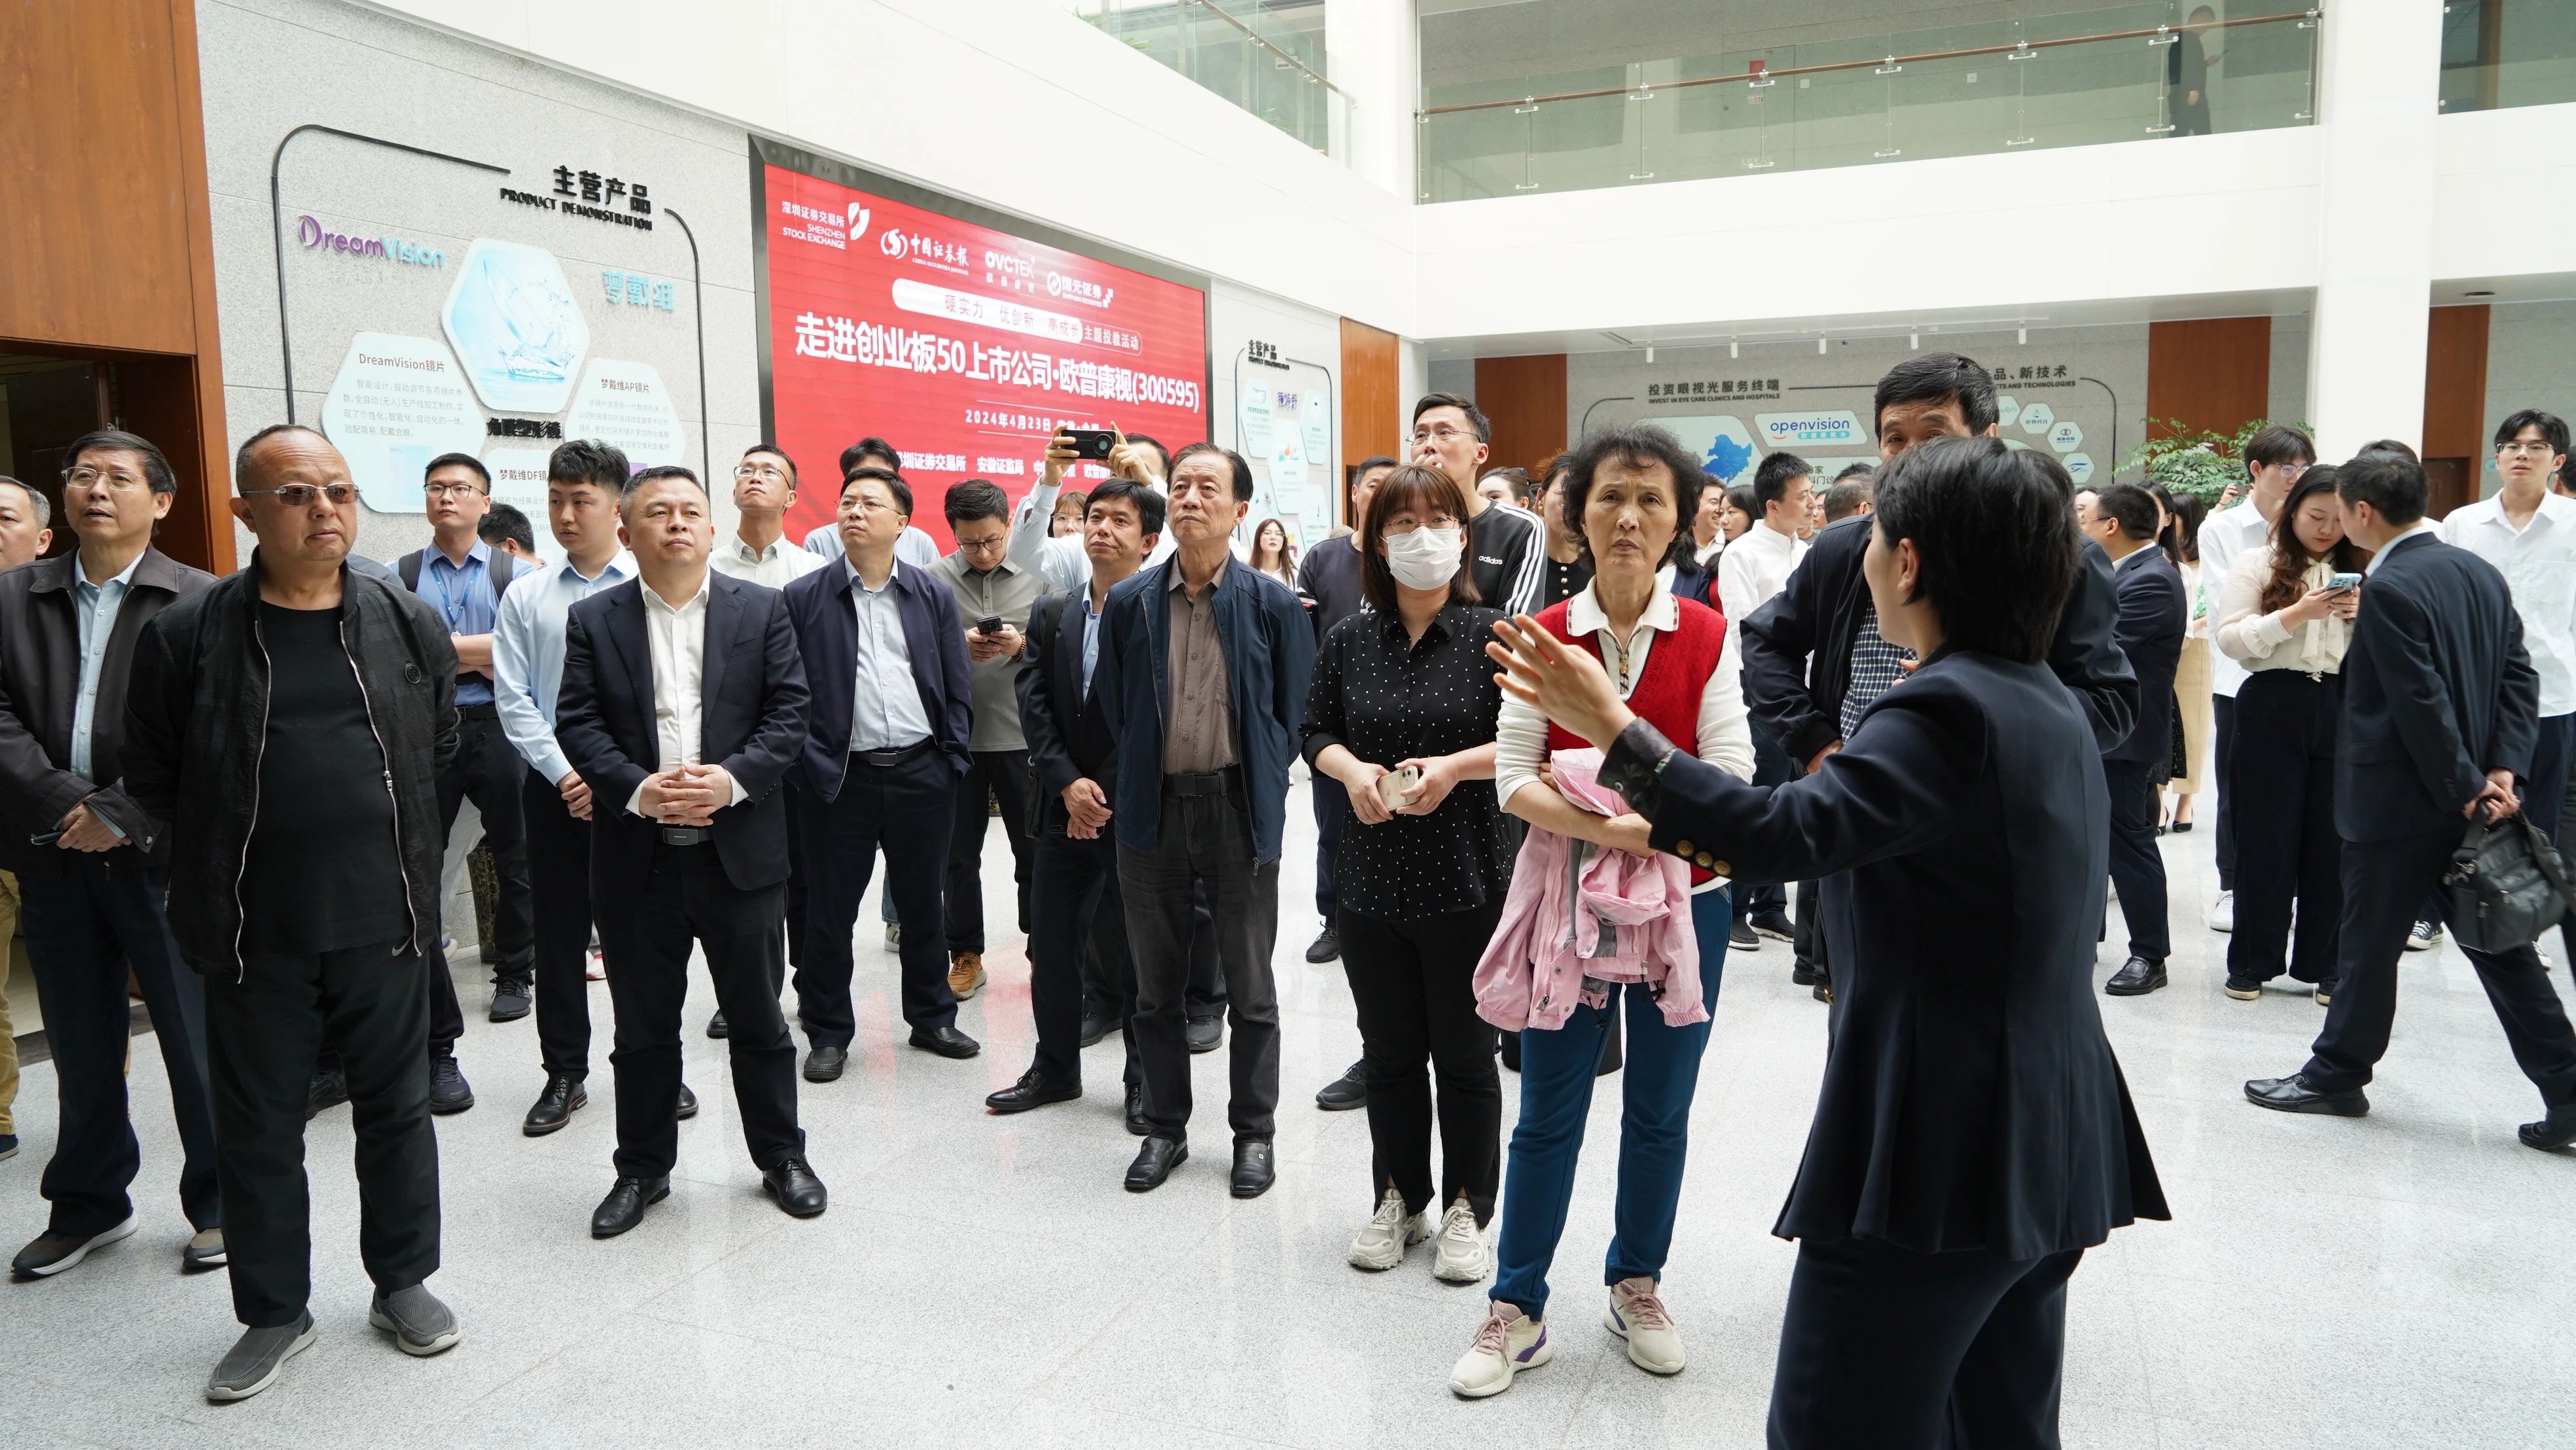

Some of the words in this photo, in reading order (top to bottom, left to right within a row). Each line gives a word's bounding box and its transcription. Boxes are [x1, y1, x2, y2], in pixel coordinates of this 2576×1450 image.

[553, 165, 651, 214] 主营产品
[500, 188, 558, 209] PRODUCT
[562, 201, 653, 230] DEMONSTRATION
[782, 201, 844, 228] 深圳证券交易所
[298, 215, 446, 267] DreamVision
[783, 227, 806, 240] STOCK
[807, 233, 846, 250] EXCHANGE
[807, 224, 846, 240] SHENZHEN
[985, 251, 1035, 278] OVCTEK
[1062, 276, 1102, 299] 国元证券
[945, 294, 983, 318] 硬实力
[999, 306, 1034, 330] 优创新
[1048, 317, 1079, 338] 高成长
[1084, 325, 1139, 351] 主题投教活动
[1248, 340, 1277, 360] 主营产品
[359, 353, 445, 373] DreamVision镜片
[601, 378, 650, 393] 梦戴维AP镜片
[1649, 379, 1780, 396] 投资眼视光服务终端
[2024, 380, 2075, 389] TECHNOLOGIES
[966, 410, 1051, 432] 2024年4月23日
[1770, 417, 1850, 434] openvision
[977, 456, 1024, 475] 安徽证监局
[1478, 556, 1503, 565] adidas
